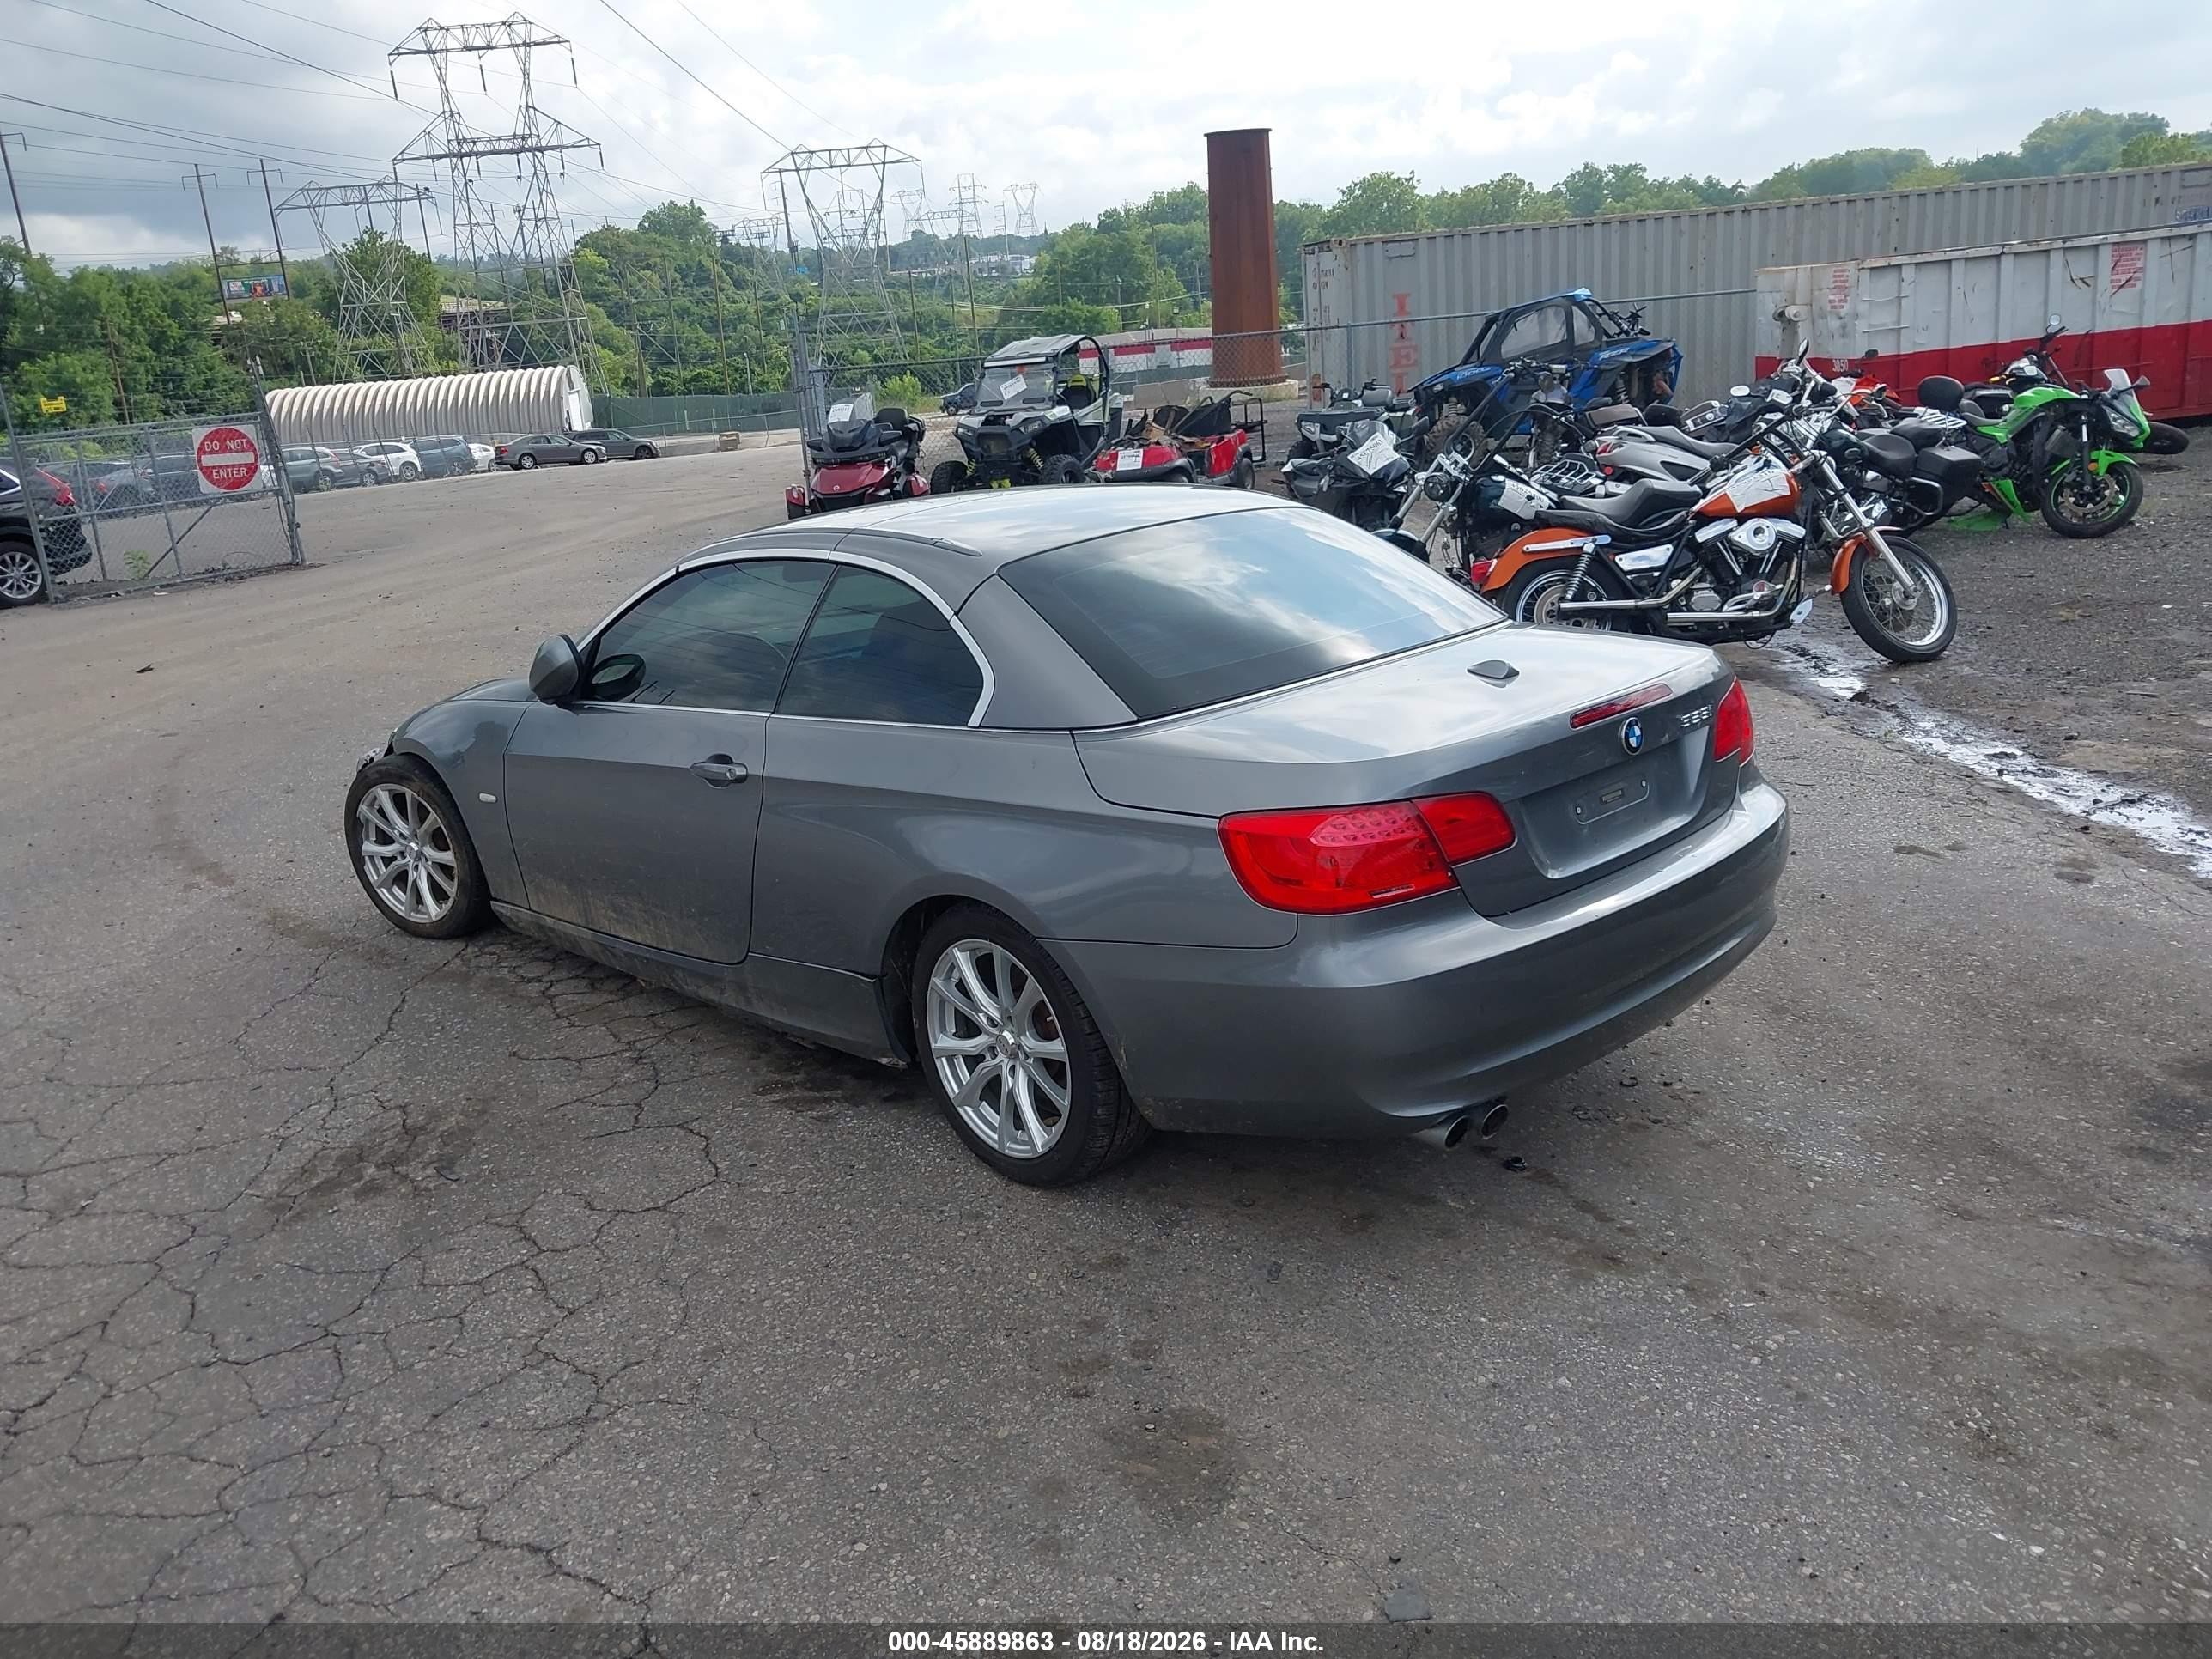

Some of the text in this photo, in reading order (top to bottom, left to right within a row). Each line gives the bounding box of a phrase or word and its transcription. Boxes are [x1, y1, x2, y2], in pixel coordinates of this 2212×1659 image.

[1832, 359, 1849, 372] 3050
[204, 439, 248, 452] DO NOT
[212, 467, 247, 479] ENTER
